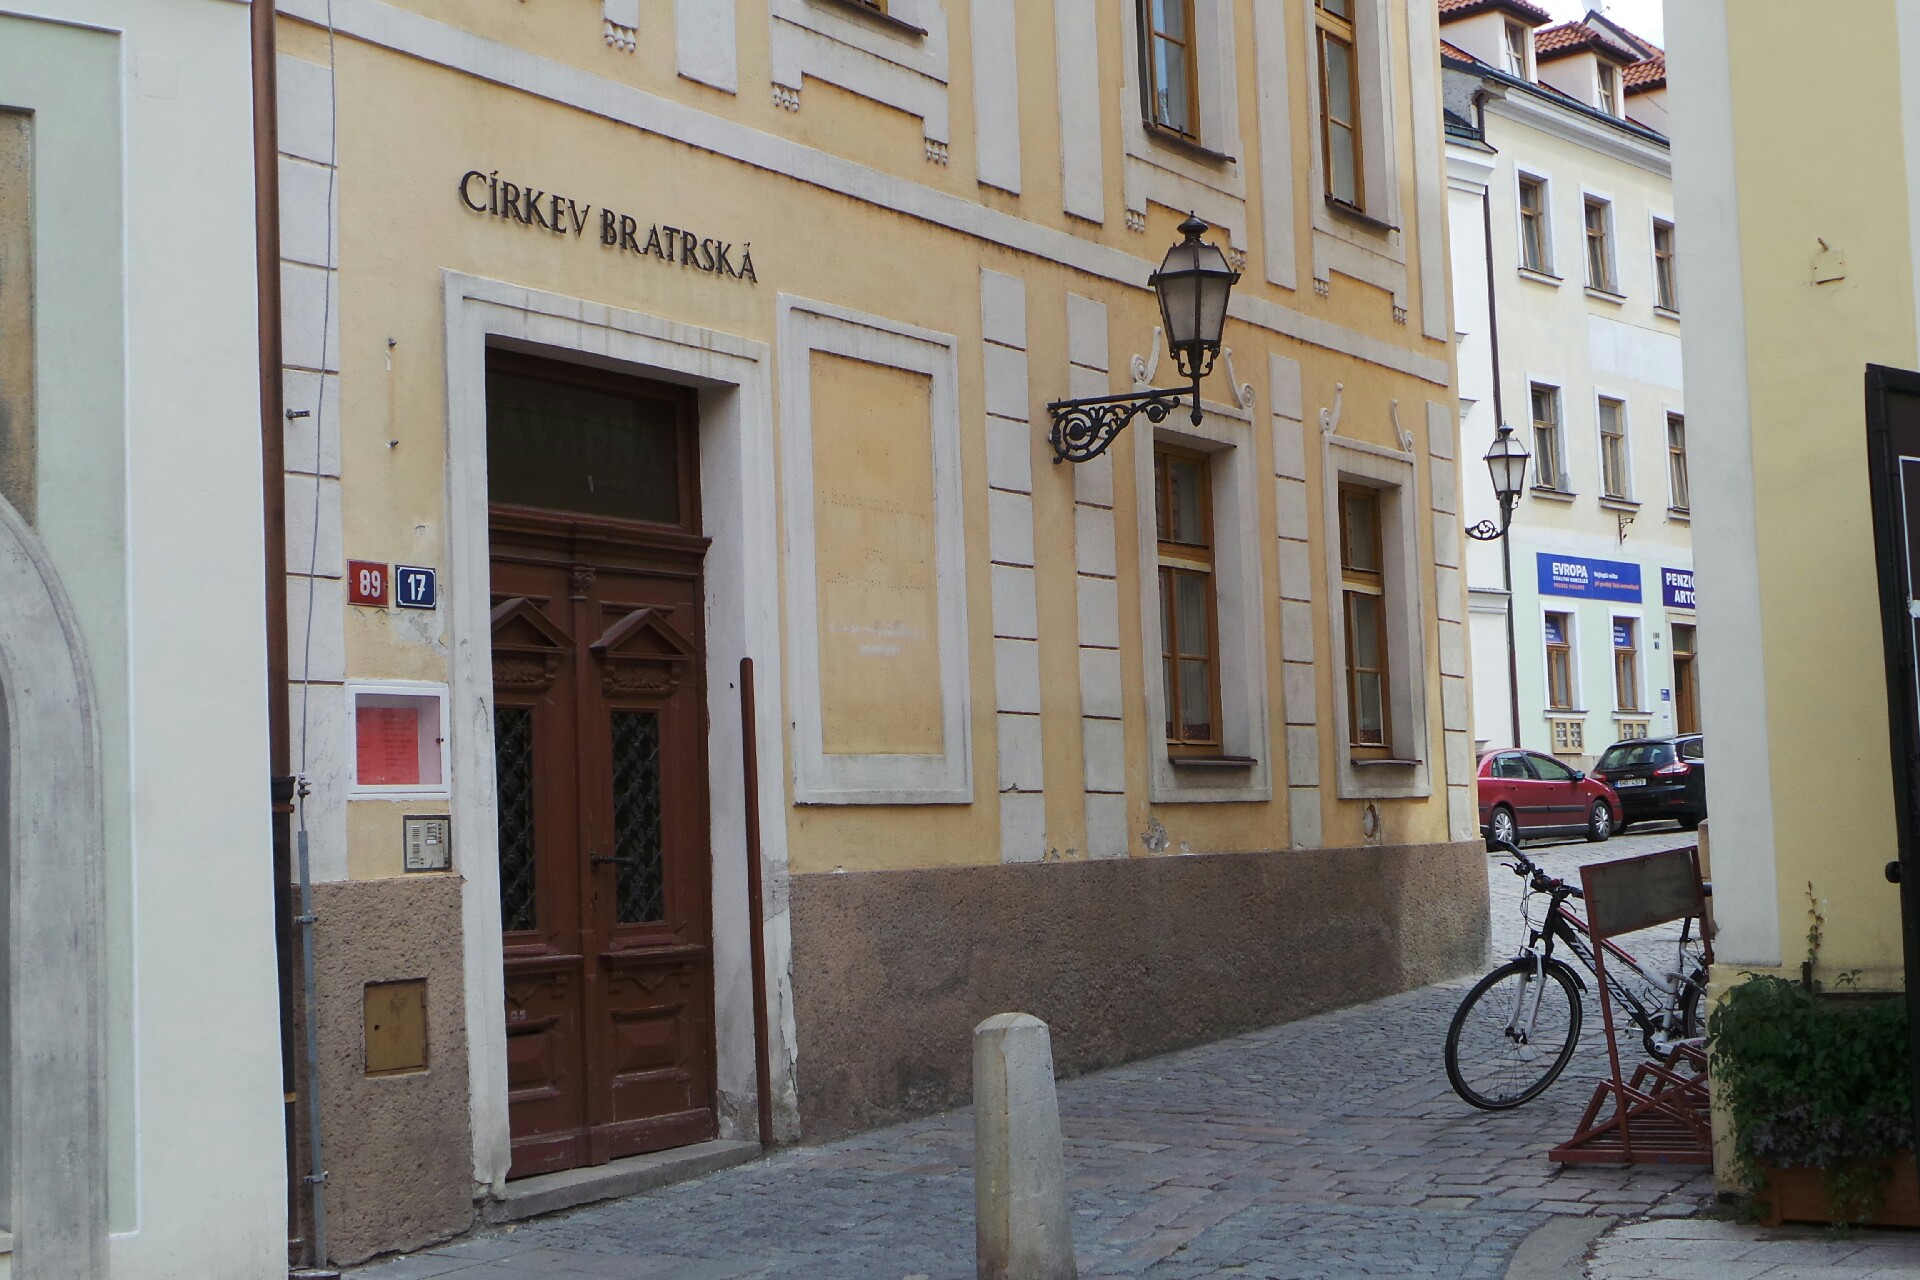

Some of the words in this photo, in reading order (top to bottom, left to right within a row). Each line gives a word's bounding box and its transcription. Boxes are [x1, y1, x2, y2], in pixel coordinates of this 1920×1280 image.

[459, 170, 591, 237] CÍRKEV
[600, 207, 758, 283] BRATRSKÁ
[360, 569, 381, 598] 89
[1552, 562, 1588, 577] EVROPA
[407, 573, 426, 600] 17
[1570, 942, 1639, 1014] MEIDA
